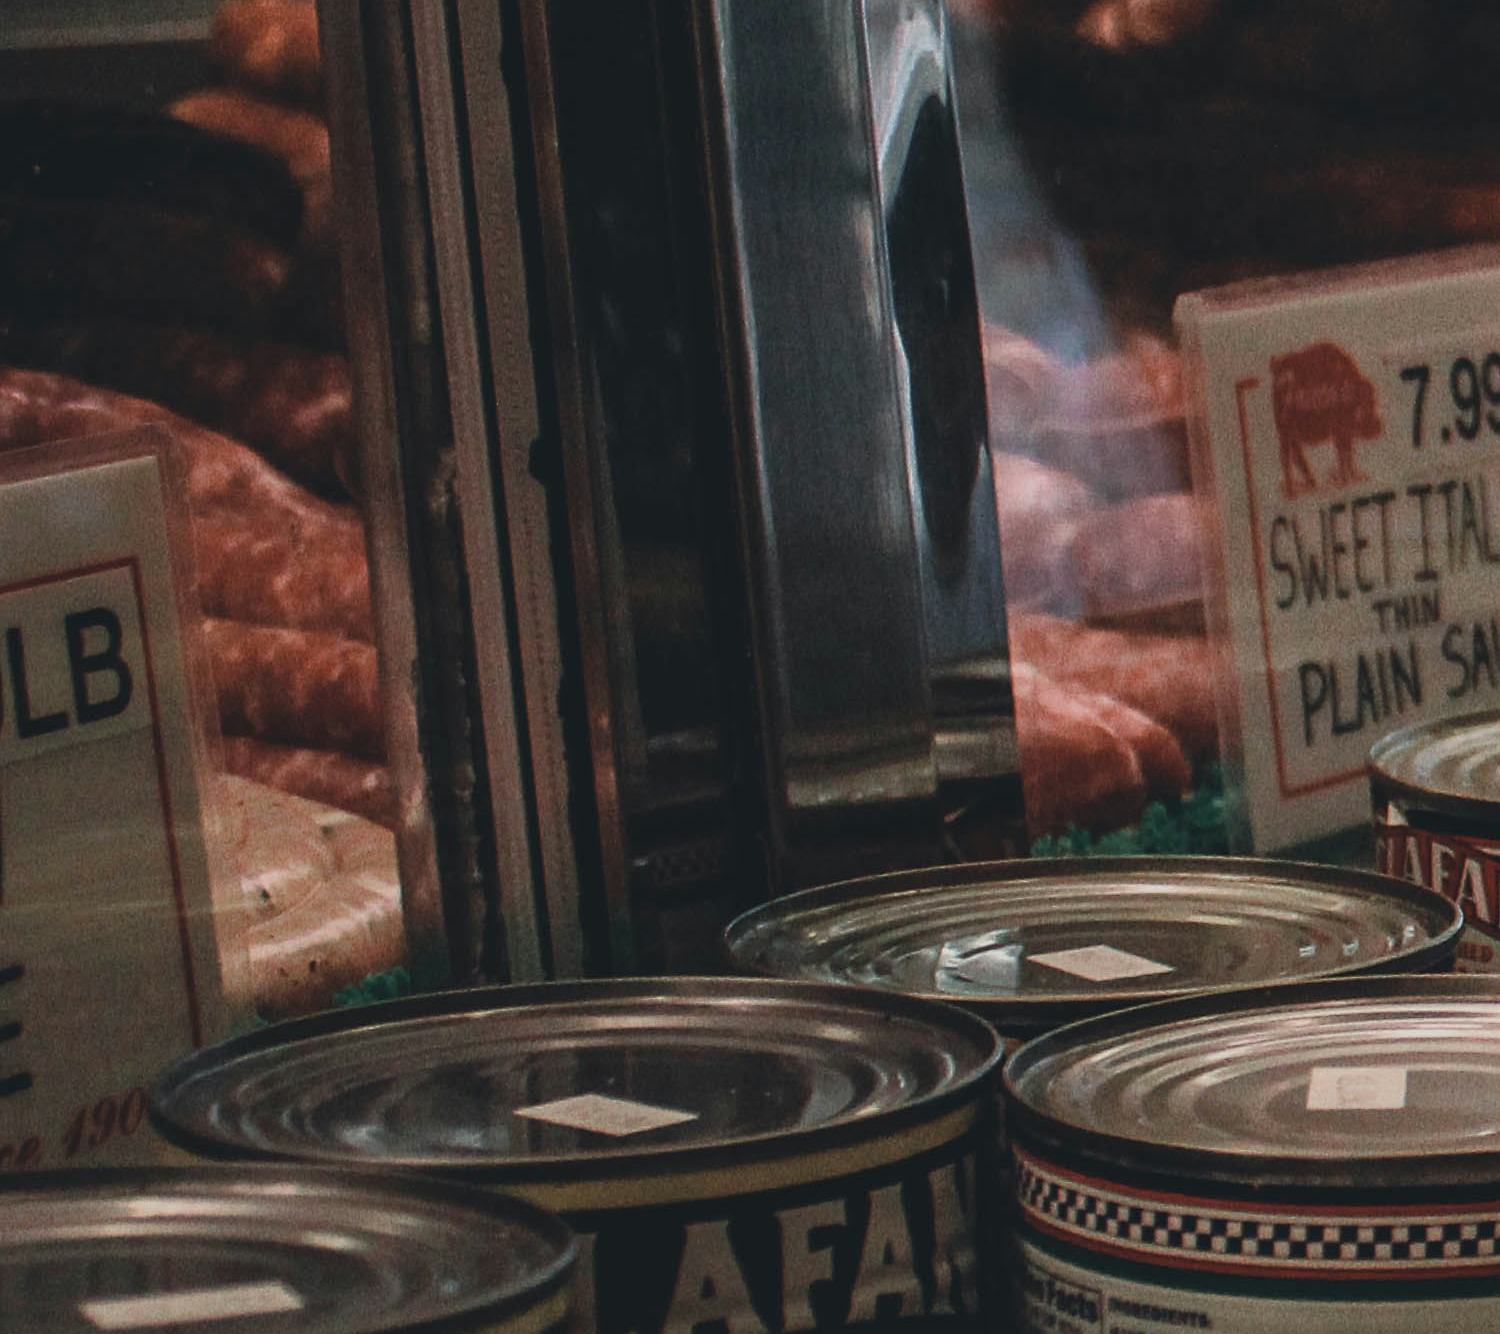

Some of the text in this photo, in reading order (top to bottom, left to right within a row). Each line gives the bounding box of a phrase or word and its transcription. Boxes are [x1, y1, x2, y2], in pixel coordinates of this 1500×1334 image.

[1270, 488, 1396, 609] SWEET
[1372, 589, 1441, 633] THIN
[0, 607, 133, 739] LB
[1299, 639, 1422, 744] PLAIN
